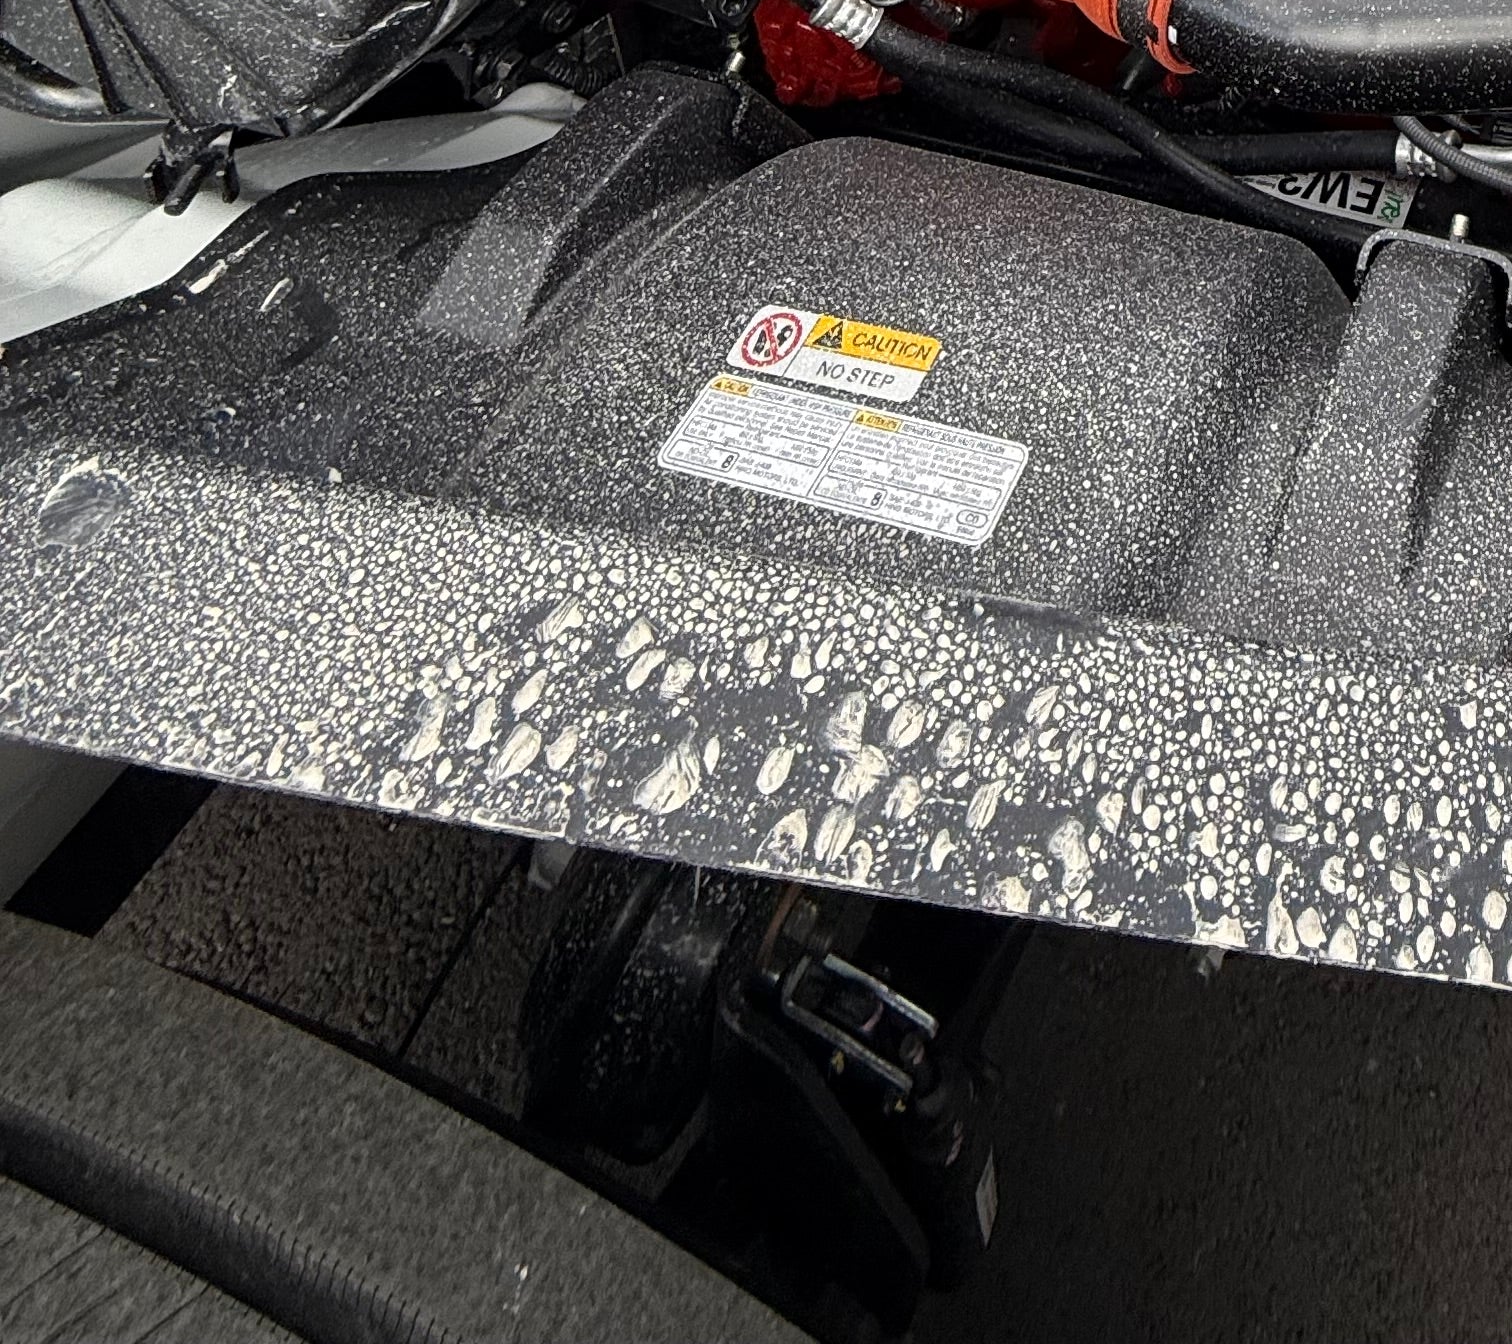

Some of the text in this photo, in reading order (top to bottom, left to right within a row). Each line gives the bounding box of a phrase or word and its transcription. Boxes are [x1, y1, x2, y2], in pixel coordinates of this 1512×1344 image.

[853, 332, 932, 360] CAUTION
[816, 361, 894, 388] NO STEP
[721, 453, 734, 470] 8
